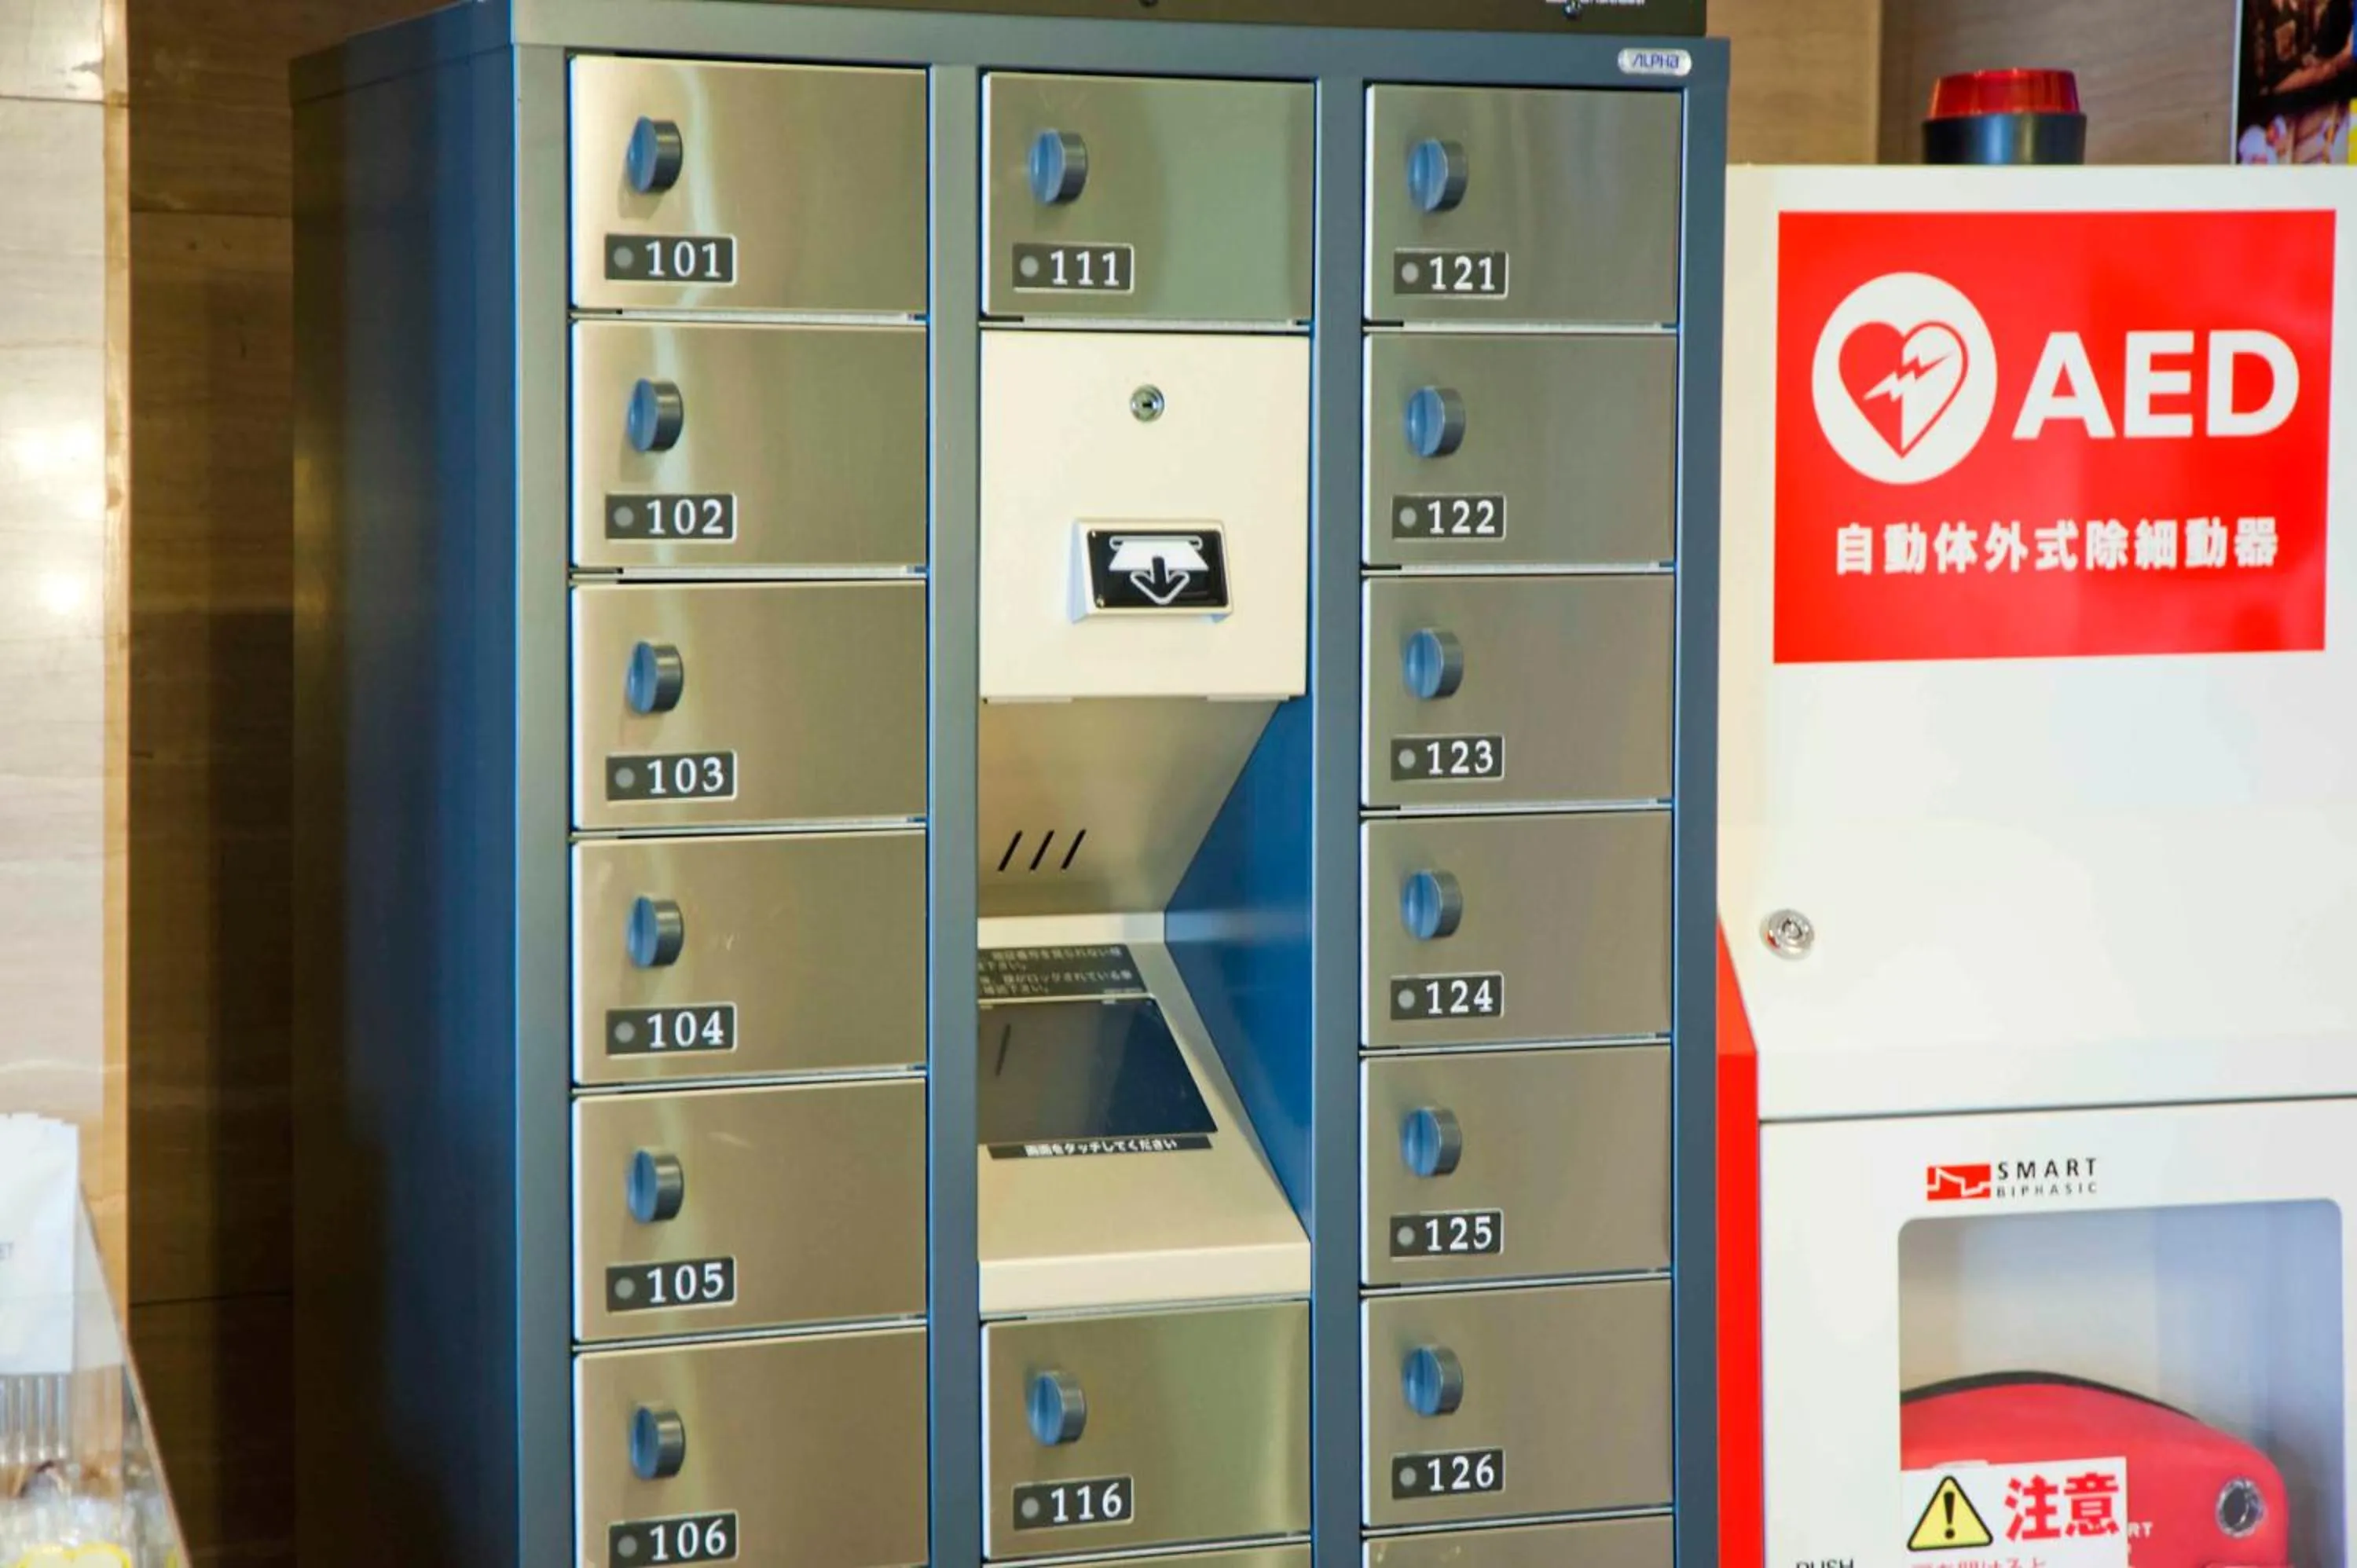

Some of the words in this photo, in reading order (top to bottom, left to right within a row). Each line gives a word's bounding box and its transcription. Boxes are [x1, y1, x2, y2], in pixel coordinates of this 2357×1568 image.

[1631, 52, 1680, 69] ALPHA
[646, 241, 722, 277] 101
[1050, 250, 1120, 286] 111
[1430, 255, 1496, 291] 121
[2011, 328, 2300, 440] AED
[647, 499, 724, 535] 102
[1428, 500, 1496, 534] 122
[1835, 516, 2279, 574] 自動体外式除細動器
[1427, 739, 1494, 775] 123
[647, 757, 724, 794] 103
[1426, 980, 1494, 1014] 124
[647, 1010, 724, 1048] 104
[1997, 1157, 2097, 1181] SMART
[1996, 1181, 2098, 1199] BIPHASIC
[1426, 1215, 1493, 1251] 125
[647, 1262, 724, 1302] 105
[1428, 1454, 1495, 1490] 126
[1051, 1482, 1123, 1522] 116
[2003, 1471, 2120, 1541] 注意
[651, 1519, 727, 1559] 106
